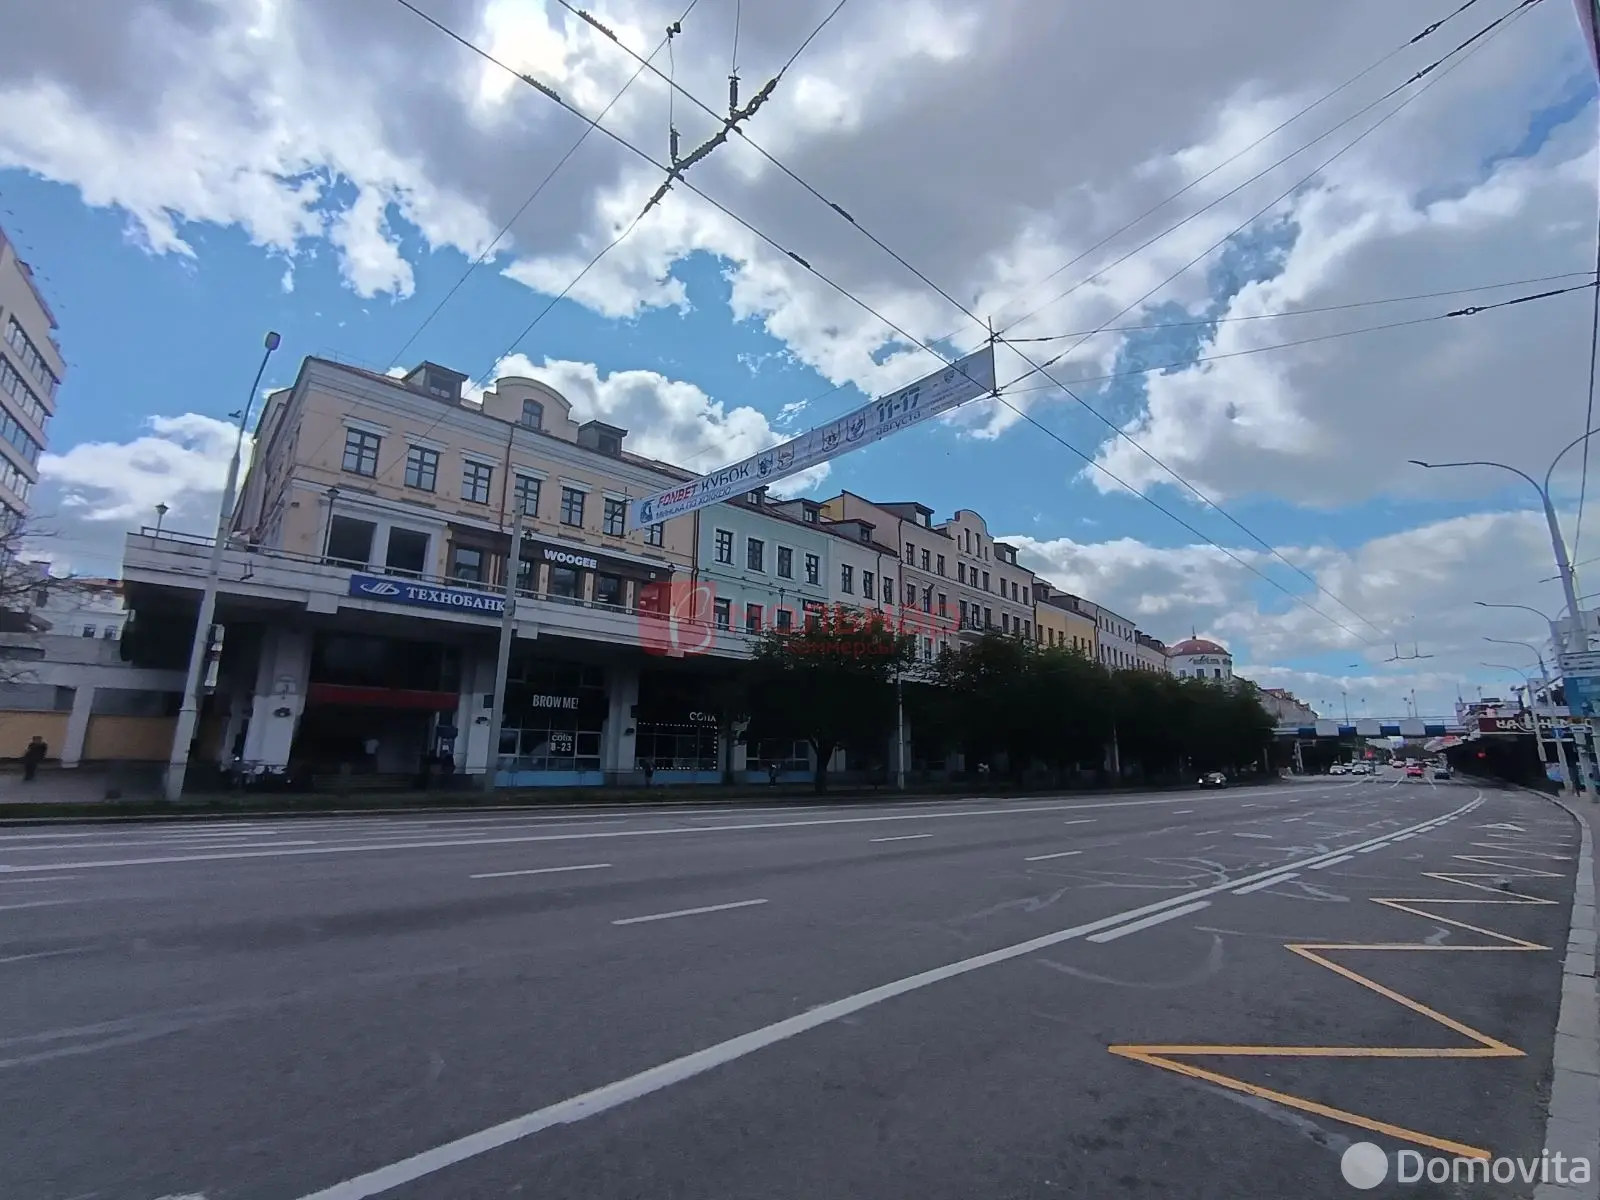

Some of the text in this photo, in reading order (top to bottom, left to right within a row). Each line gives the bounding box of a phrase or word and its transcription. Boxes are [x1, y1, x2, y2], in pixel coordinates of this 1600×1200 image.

[876, 386, 920, 422] 11-17
[876, 410, 921, 435] августа
[657, 463, 749, 508] FONBET КУБОК
[543, 549, 597, 569] WOOGEE
[406, 586, 505, 612] ТЕХНОБАНК
[532, 694, 562, 709] BROW
